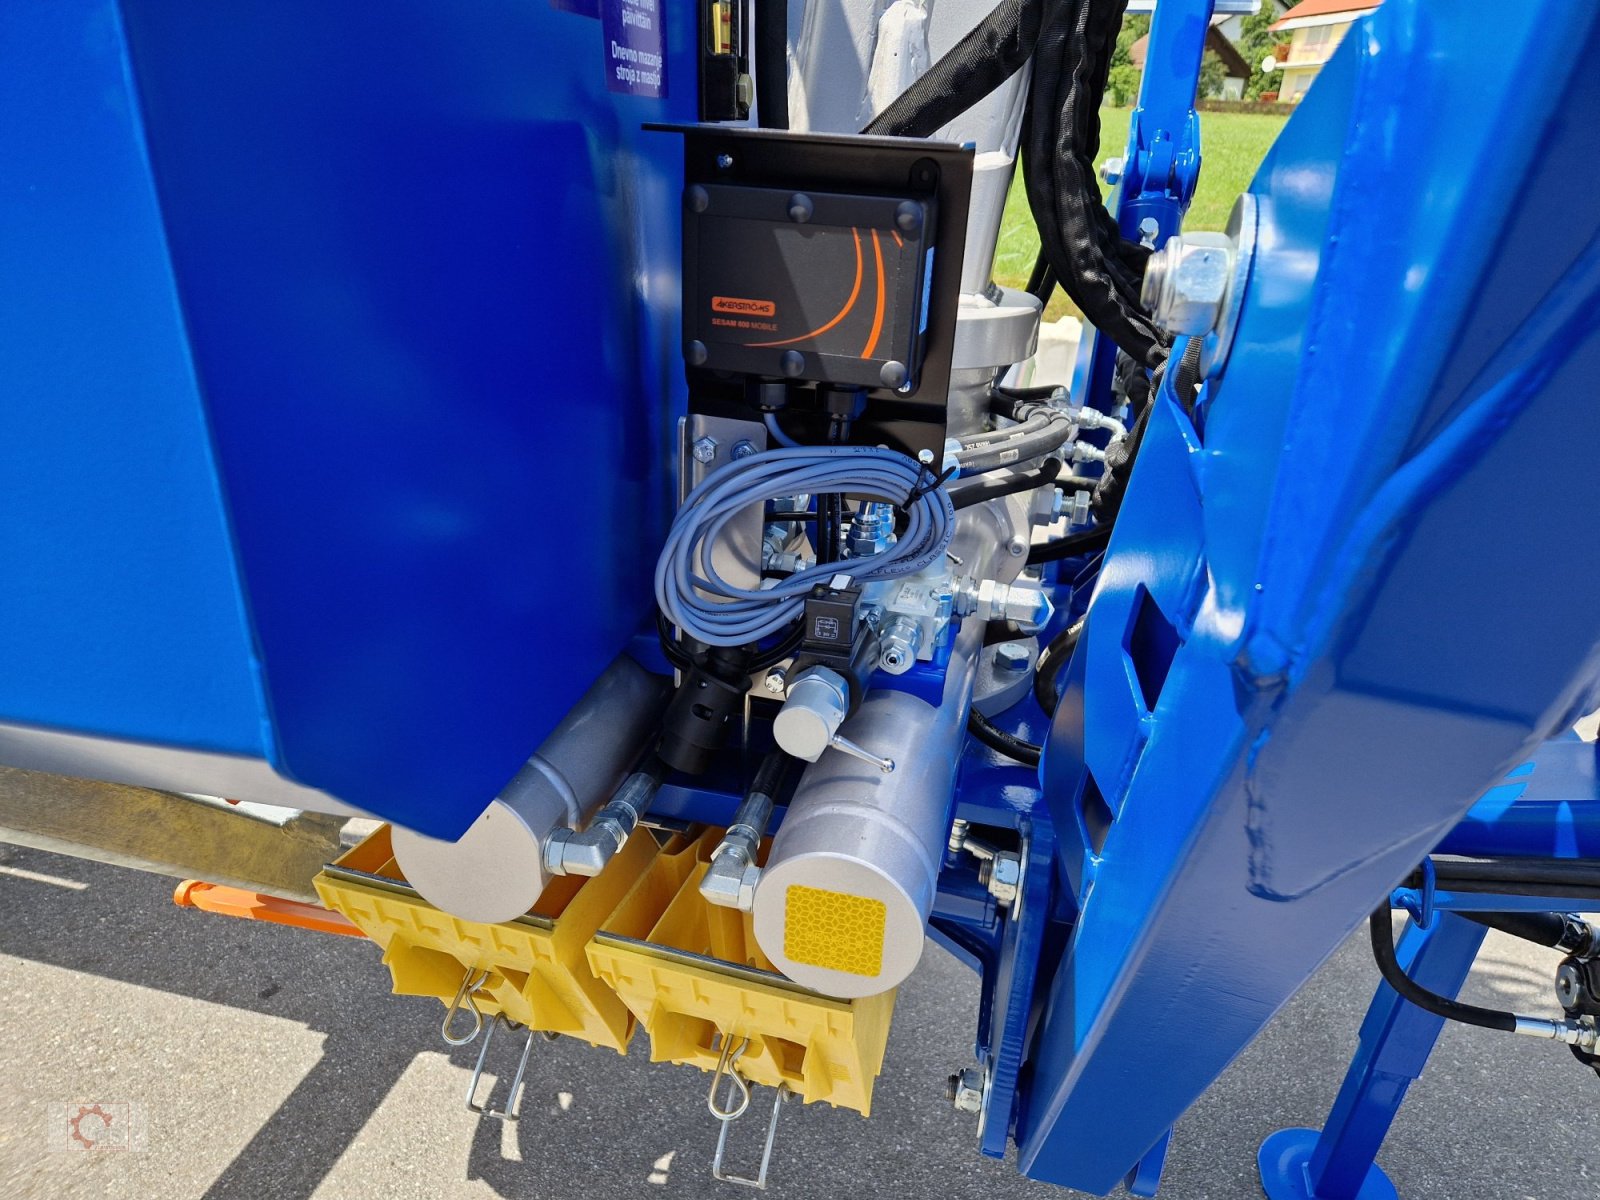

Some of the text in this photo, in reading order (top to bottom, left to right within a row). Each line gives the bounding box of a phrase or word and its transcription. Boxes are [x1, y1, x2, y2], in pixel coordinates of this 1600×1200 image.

[611, 40, 663, 70] Dnevno mazanje
[616, 64, 636, 86] stroja
[636, 70, 641, 83] z
[711, 317, 737, 327] SESAM
[751, 321, 779, 332] MOBILE
